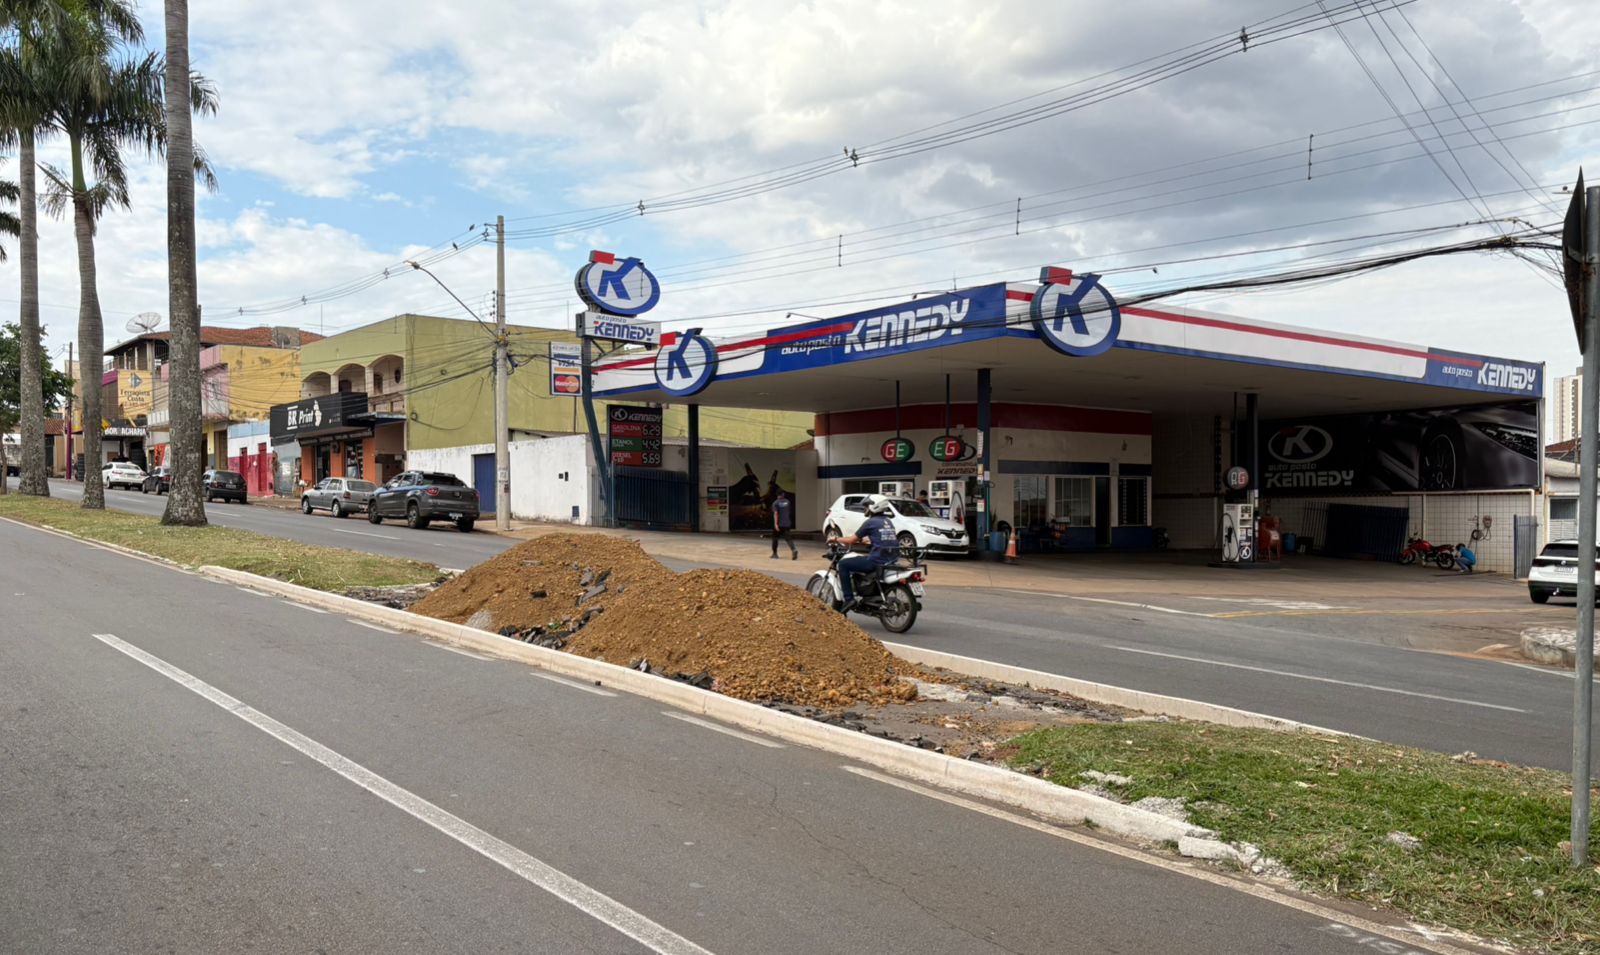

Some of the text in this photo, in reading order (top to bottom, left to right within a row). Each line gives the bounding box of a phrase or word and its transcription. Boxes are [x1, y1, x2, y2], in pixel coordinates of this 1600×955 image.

[594, 321, 655, 341] KENNEDY
[844, 298, 970, 354] KENNEDY
[1442, 366, 1473, 378] auto posto
[1477, 362, 1536, 391] KENNEDY
[287, 410, 297, 426] BR
[298, 408, 314, 424] Print
[885, 443, 906, 458] GE
[934, 441, 957, 456] EG
[1264, 470, 1354, 488] KENNEDY
